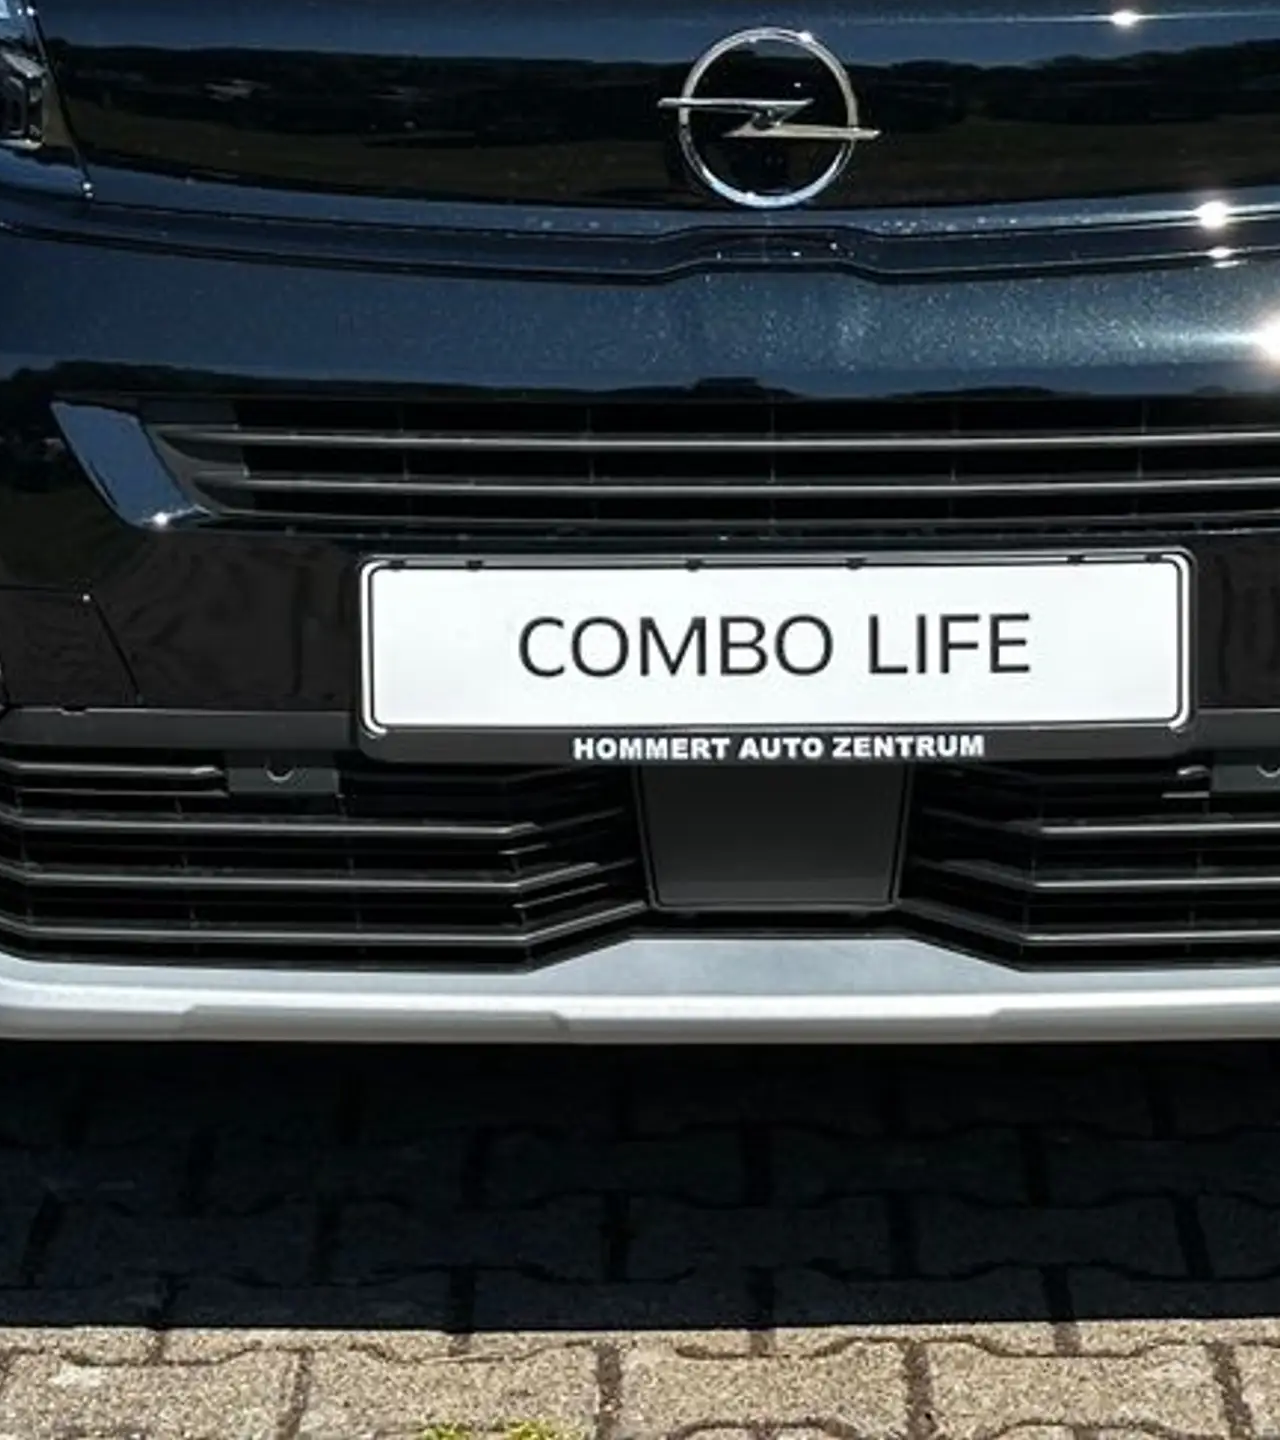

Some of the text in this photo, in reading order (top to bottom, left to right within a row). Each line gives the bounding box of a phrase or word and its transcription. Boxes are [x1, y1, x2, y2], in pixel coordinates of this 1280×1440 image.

[519, 612, 1031, 678] COMBO LIFE
[573, 734, 985, 760] HOMMERT AUTO ZENTRUM
